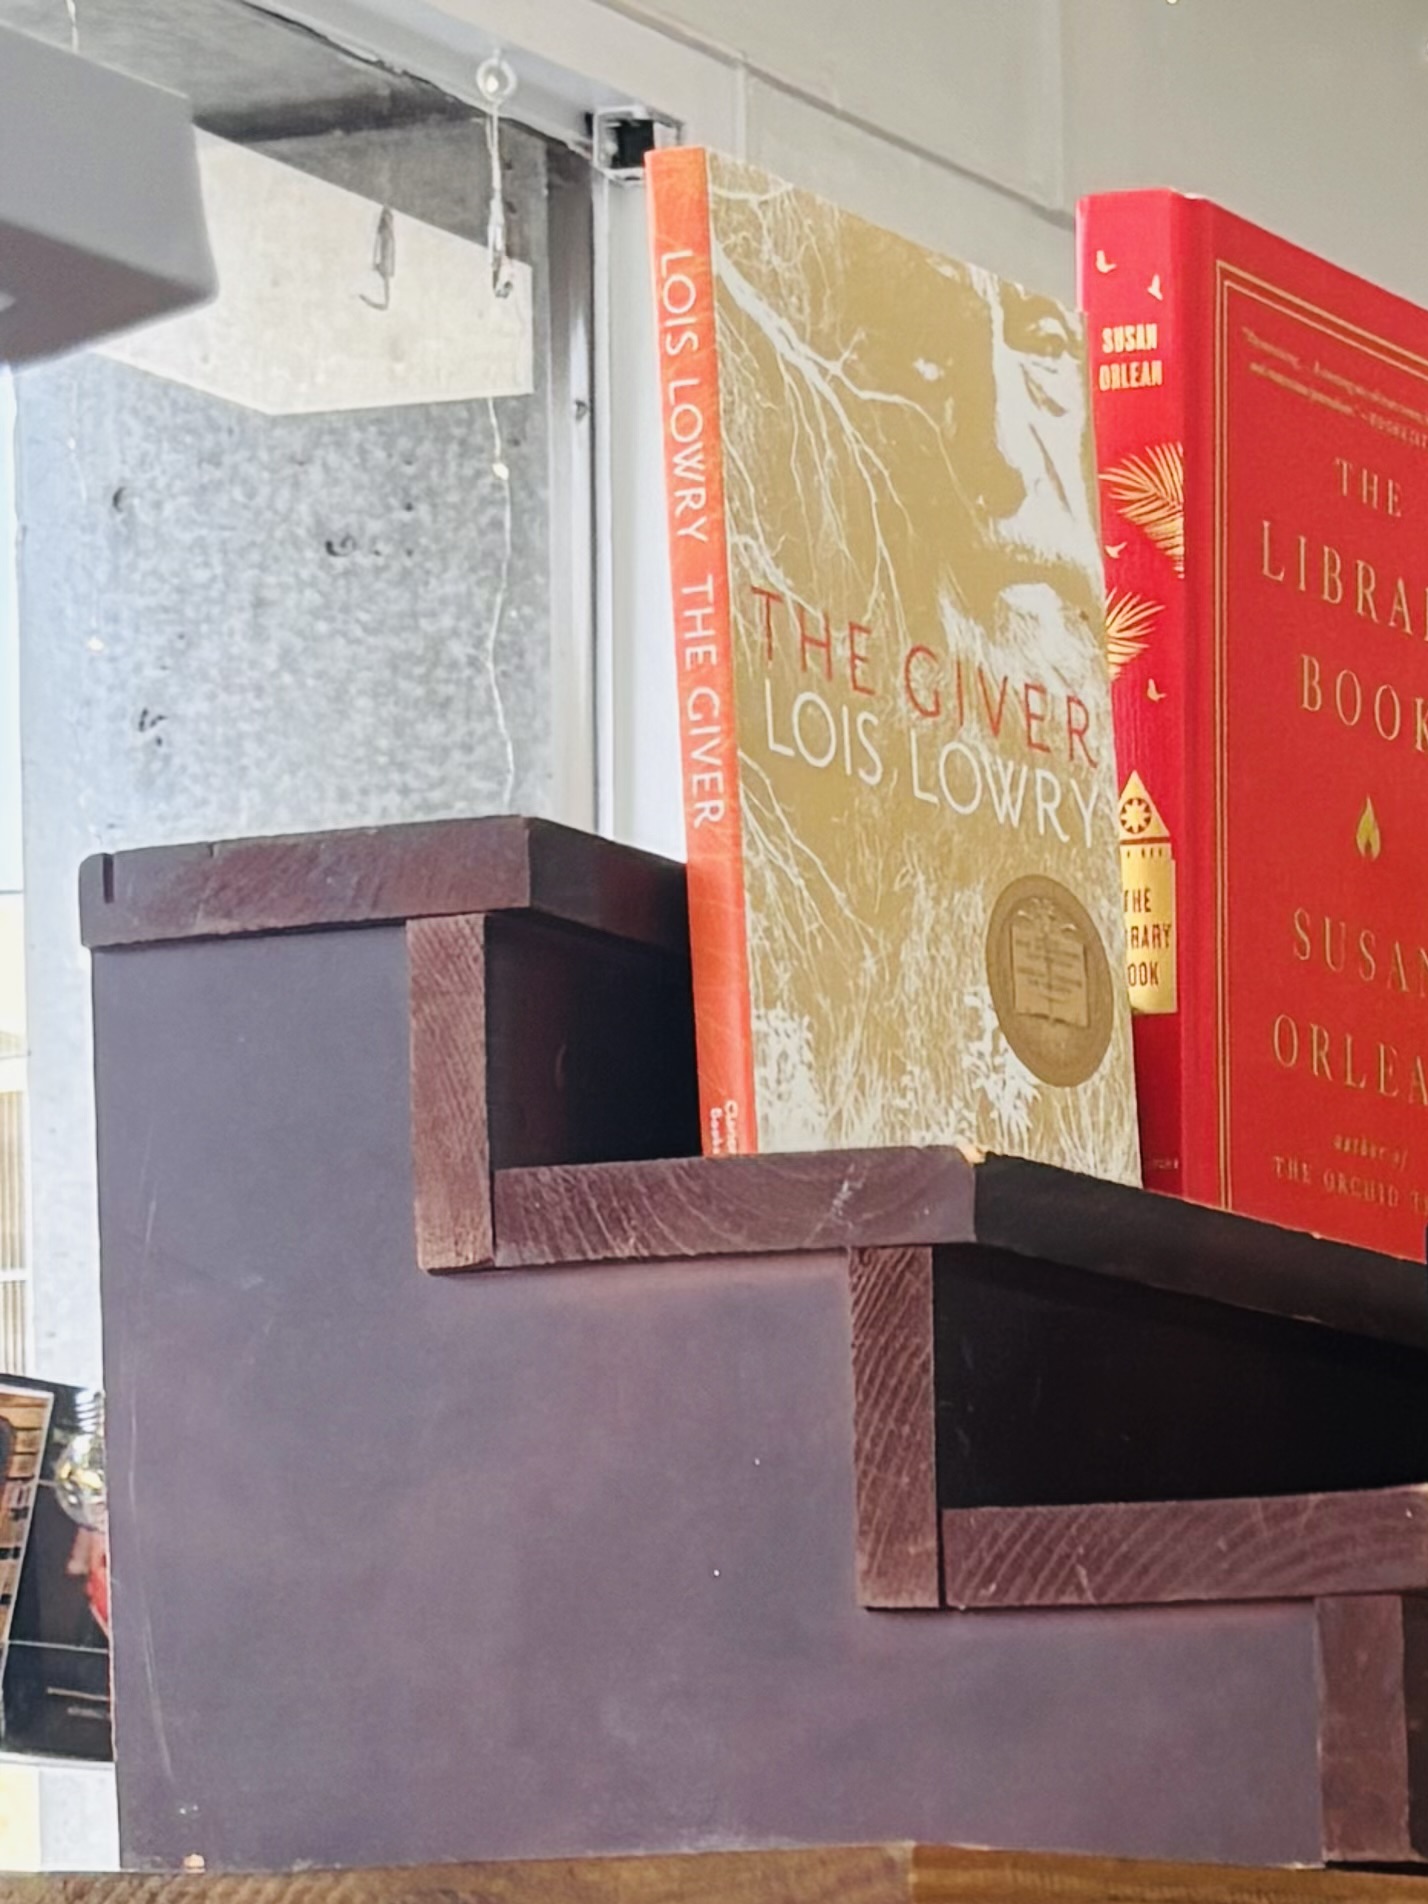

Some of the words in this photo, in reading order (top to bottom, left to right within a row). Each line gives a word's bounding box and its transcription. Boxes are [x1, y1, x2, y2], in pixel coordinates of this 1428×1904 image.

[660, 250, 697, 356] LOIS
[1101, 323, 1157, 354] SUSAN
[1099, 360, 1162, 391] ORLEAN
[666, 379, 708, 543] LOWRY
[1335, 457, 1402, 517] THE
[680, 576, 717, 666] THE
[751, 586, 877, 695] THE
[904, 644, 1098, 768] GIVER
[685, 687, 724, 828] GIVER
[765, 680, 882, 786] LOIS
[911, 731, 1098, 849] LOWRY
